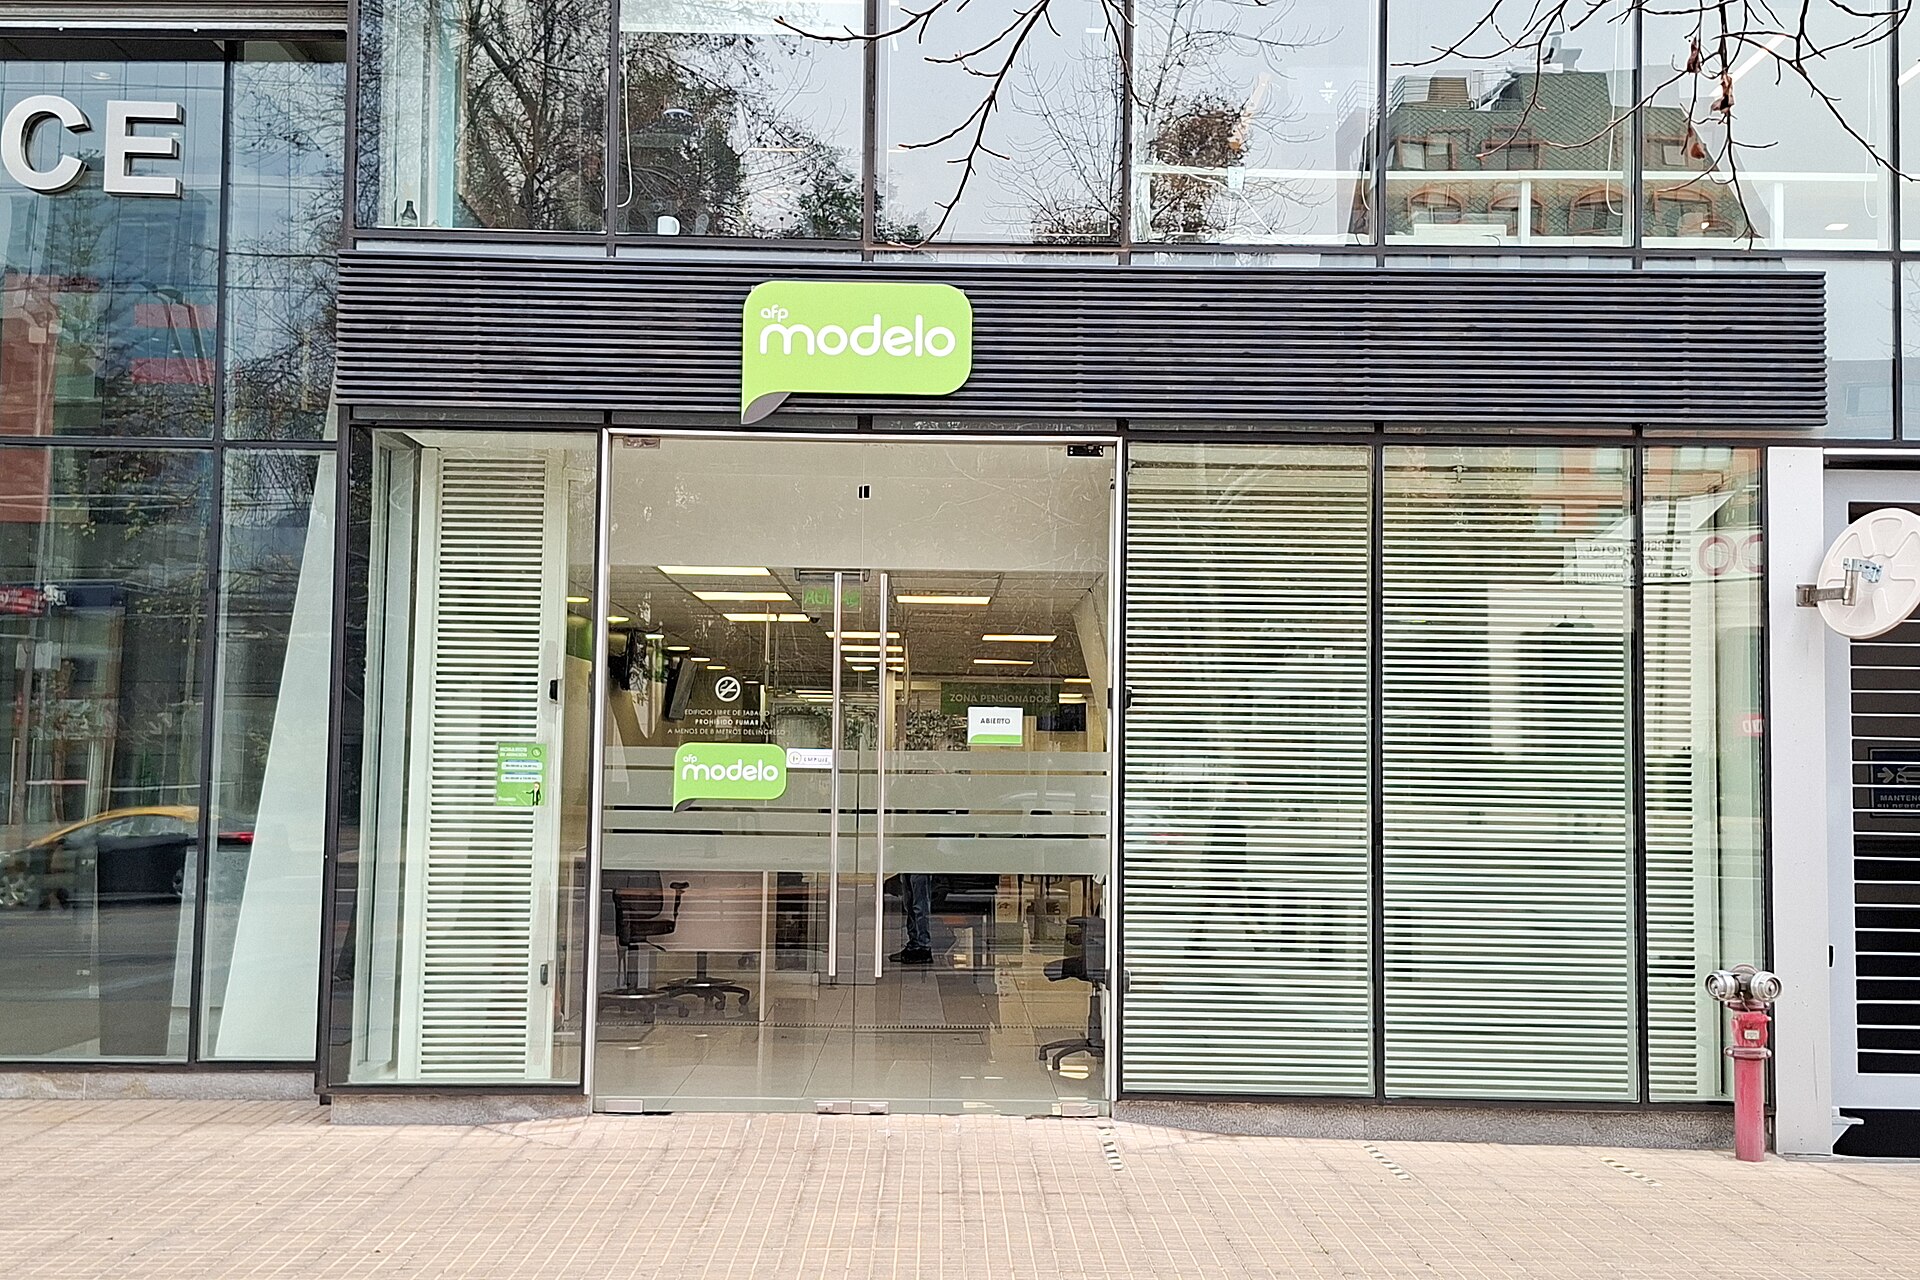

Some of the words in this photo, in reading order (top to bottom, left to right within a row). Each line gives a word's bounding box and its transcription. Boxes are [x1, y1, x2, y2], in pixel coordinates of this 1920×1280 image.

[760, 304, 789, 323] afp
[760, 313, 957, 358] modelo
[950, 693, 978, 702] ZONA
[980, 694, 1051, 703] PENSIONADOS
[695, 718, 734, 726] PROHIBIDO
[980, 717, 1011, 725] ABIERTO
[683, 753, 698, 763] afp
[682, 759, 779, 782] modelo
